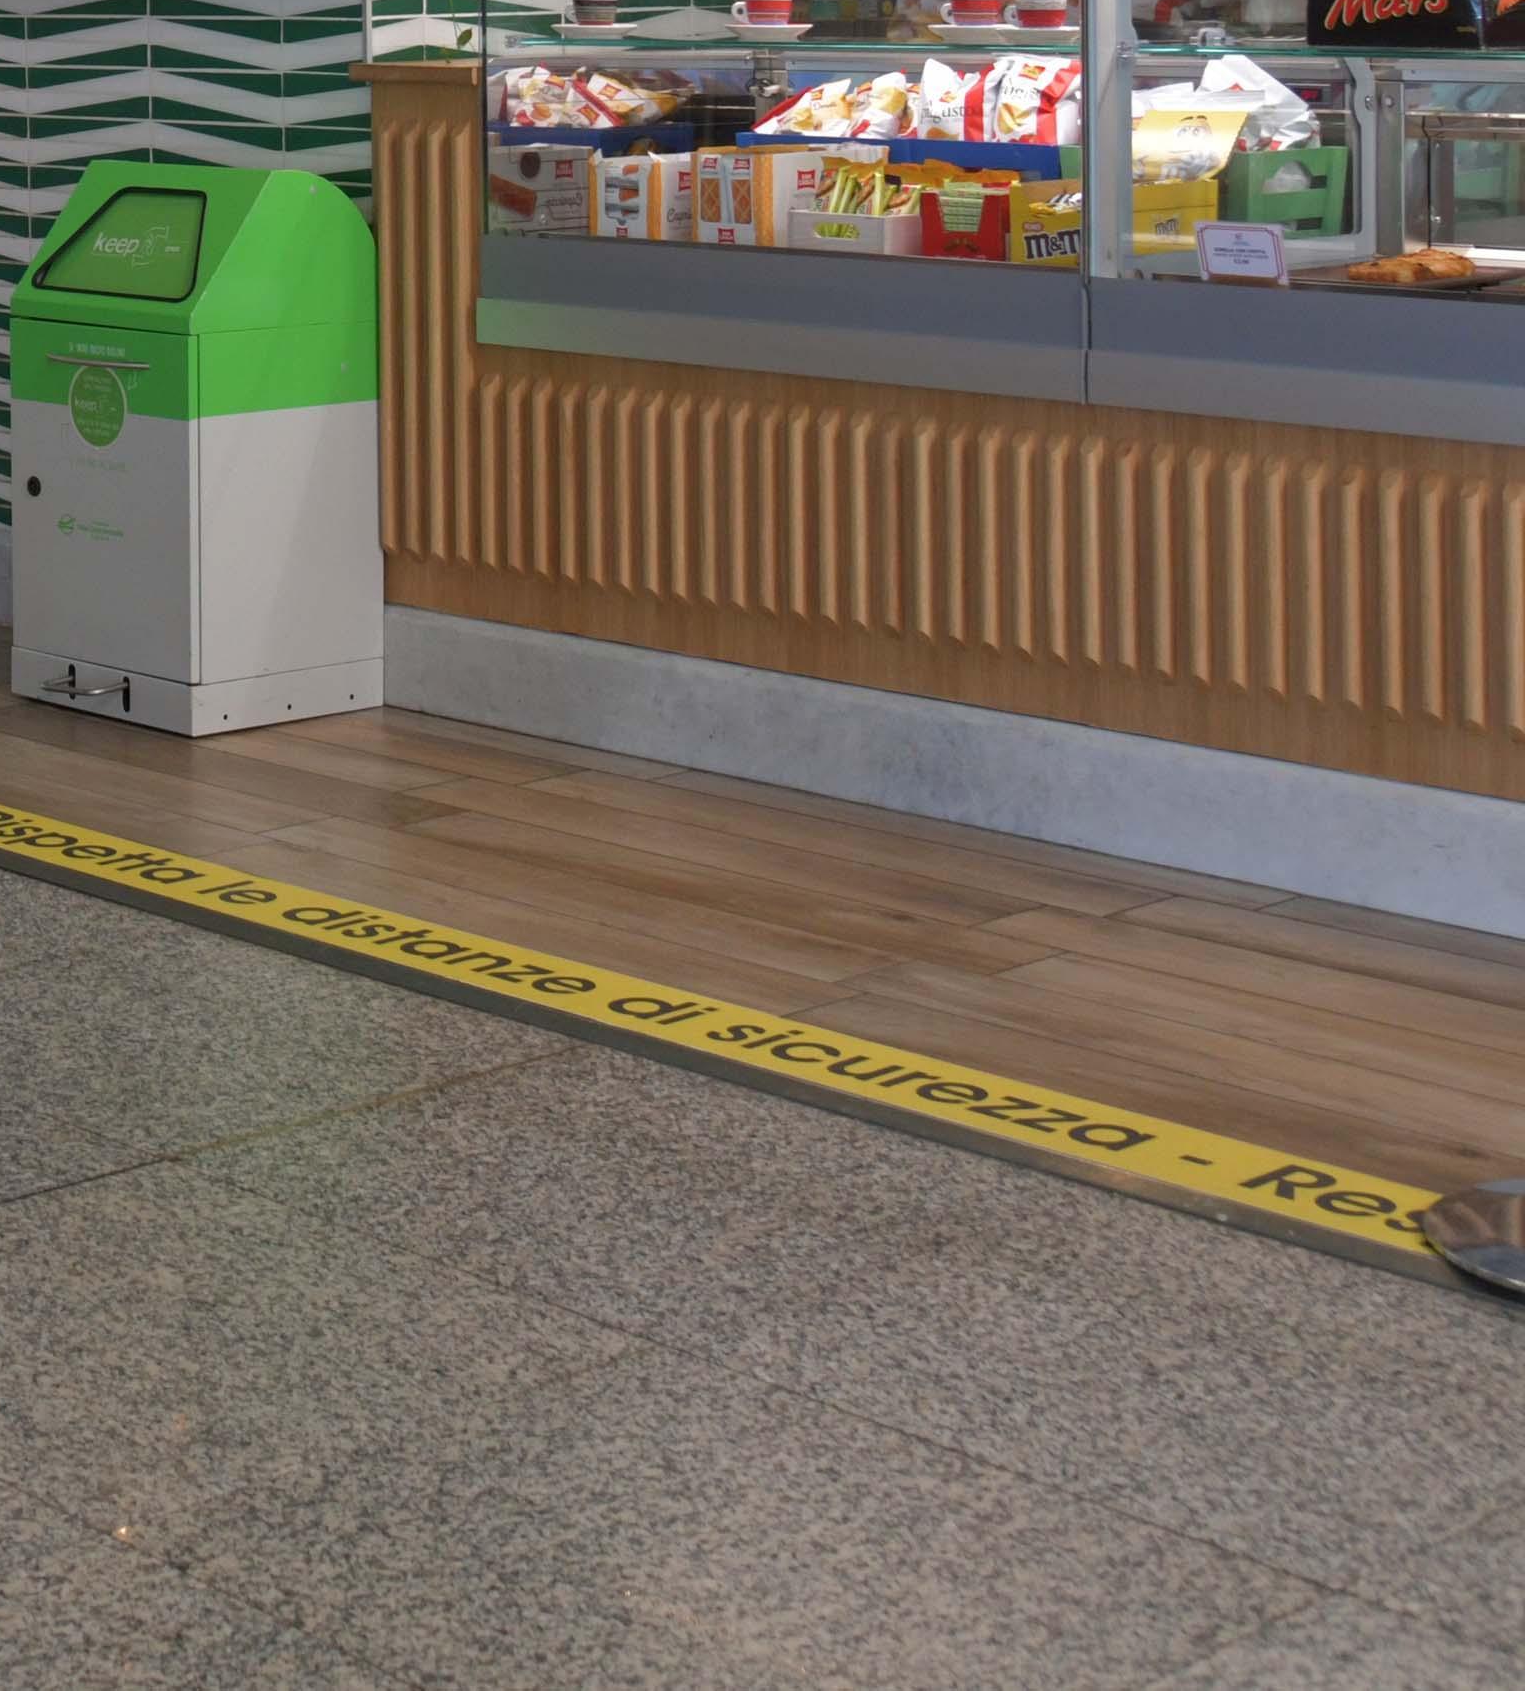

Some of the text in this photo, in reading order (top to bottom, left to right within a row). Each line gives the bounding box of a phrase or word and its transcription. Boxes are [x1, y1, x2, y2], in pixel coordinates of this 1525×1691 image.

[93, 232, 139, 257] keep
[197, 880, 280, 907] le
[282, 905, 597, 996] distanze
[608, 993, 699, 1025] di
[706, 1025, 1159, 1154] sicurezza
